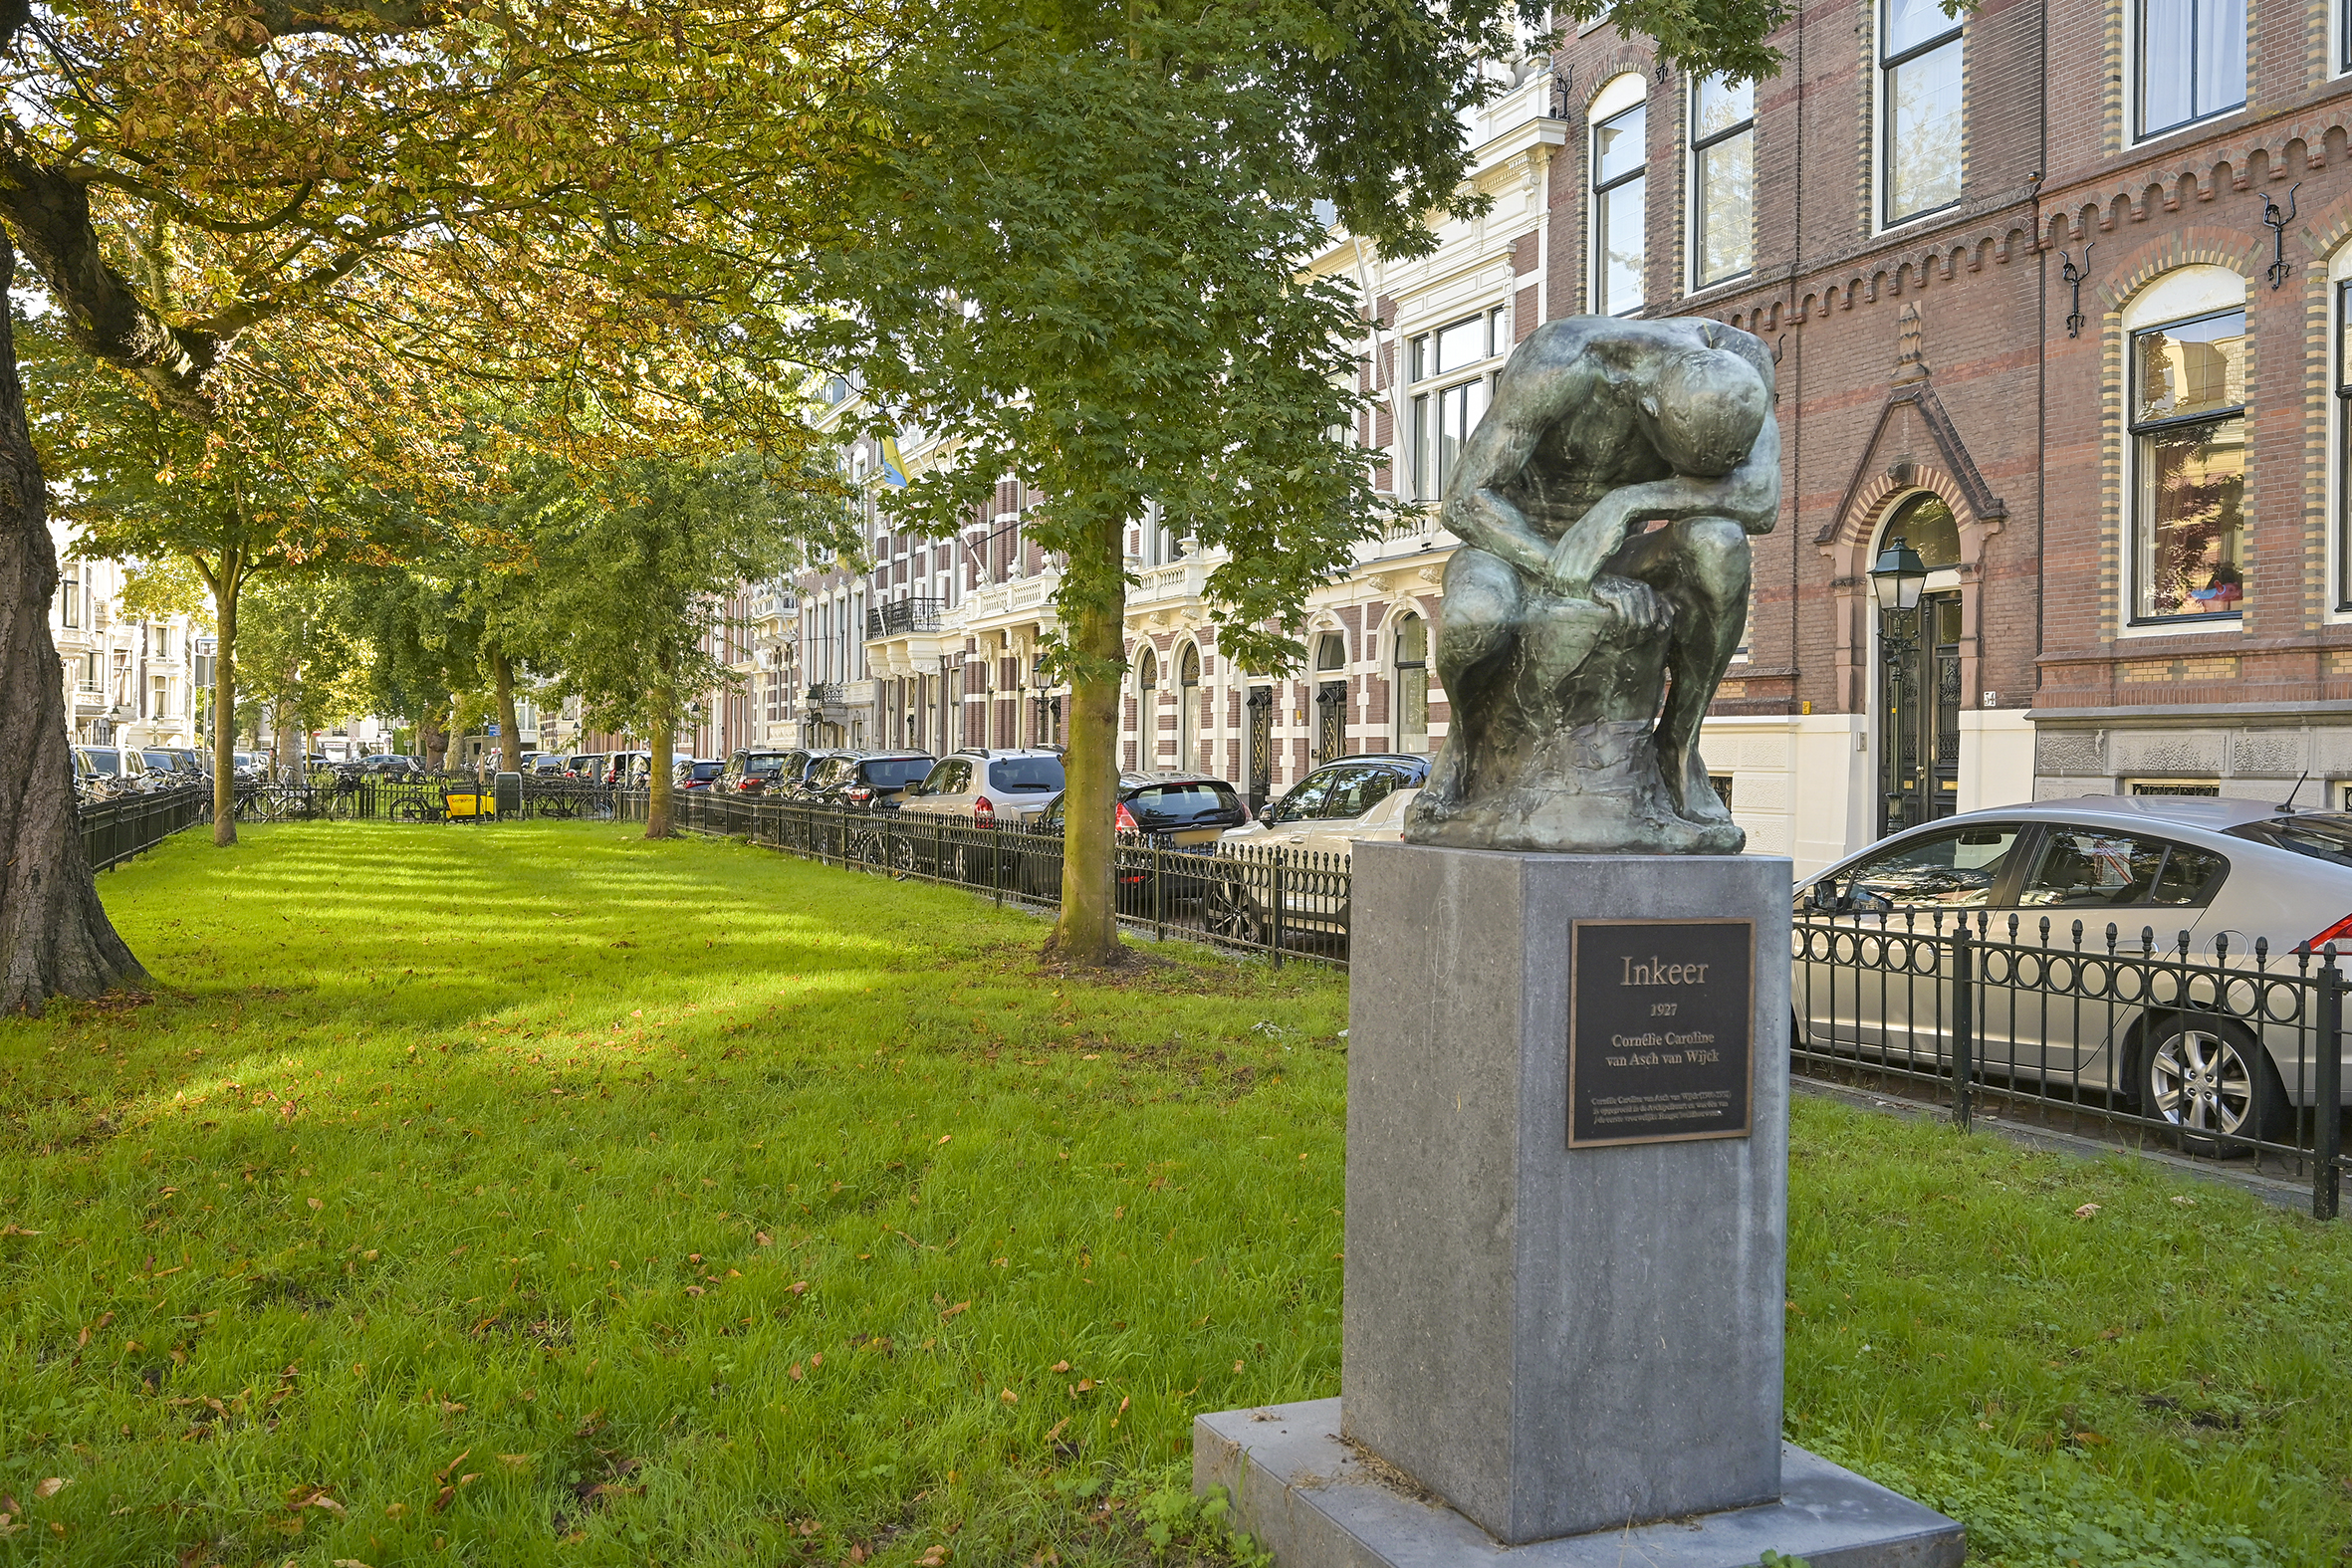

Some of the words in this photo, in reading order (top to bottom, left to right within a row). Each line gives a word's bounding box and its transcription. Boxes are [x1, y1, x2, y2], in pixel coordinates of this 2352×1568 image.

[1620, 955, 1709, 986] Inkeer
[1650, 1003, 1677, 1016] 1927
[1611, 1032, 1662, 1047] Cornélie
[1664, 1031, 1715, 1046] Caroline
[1605, 1056, 1627, 1067] van
[1629, 1052, 1659, 1066] Asch
[1662, 1053, 1683, 1064] van
[1684, 1049, 1720, 1065] Wijck
